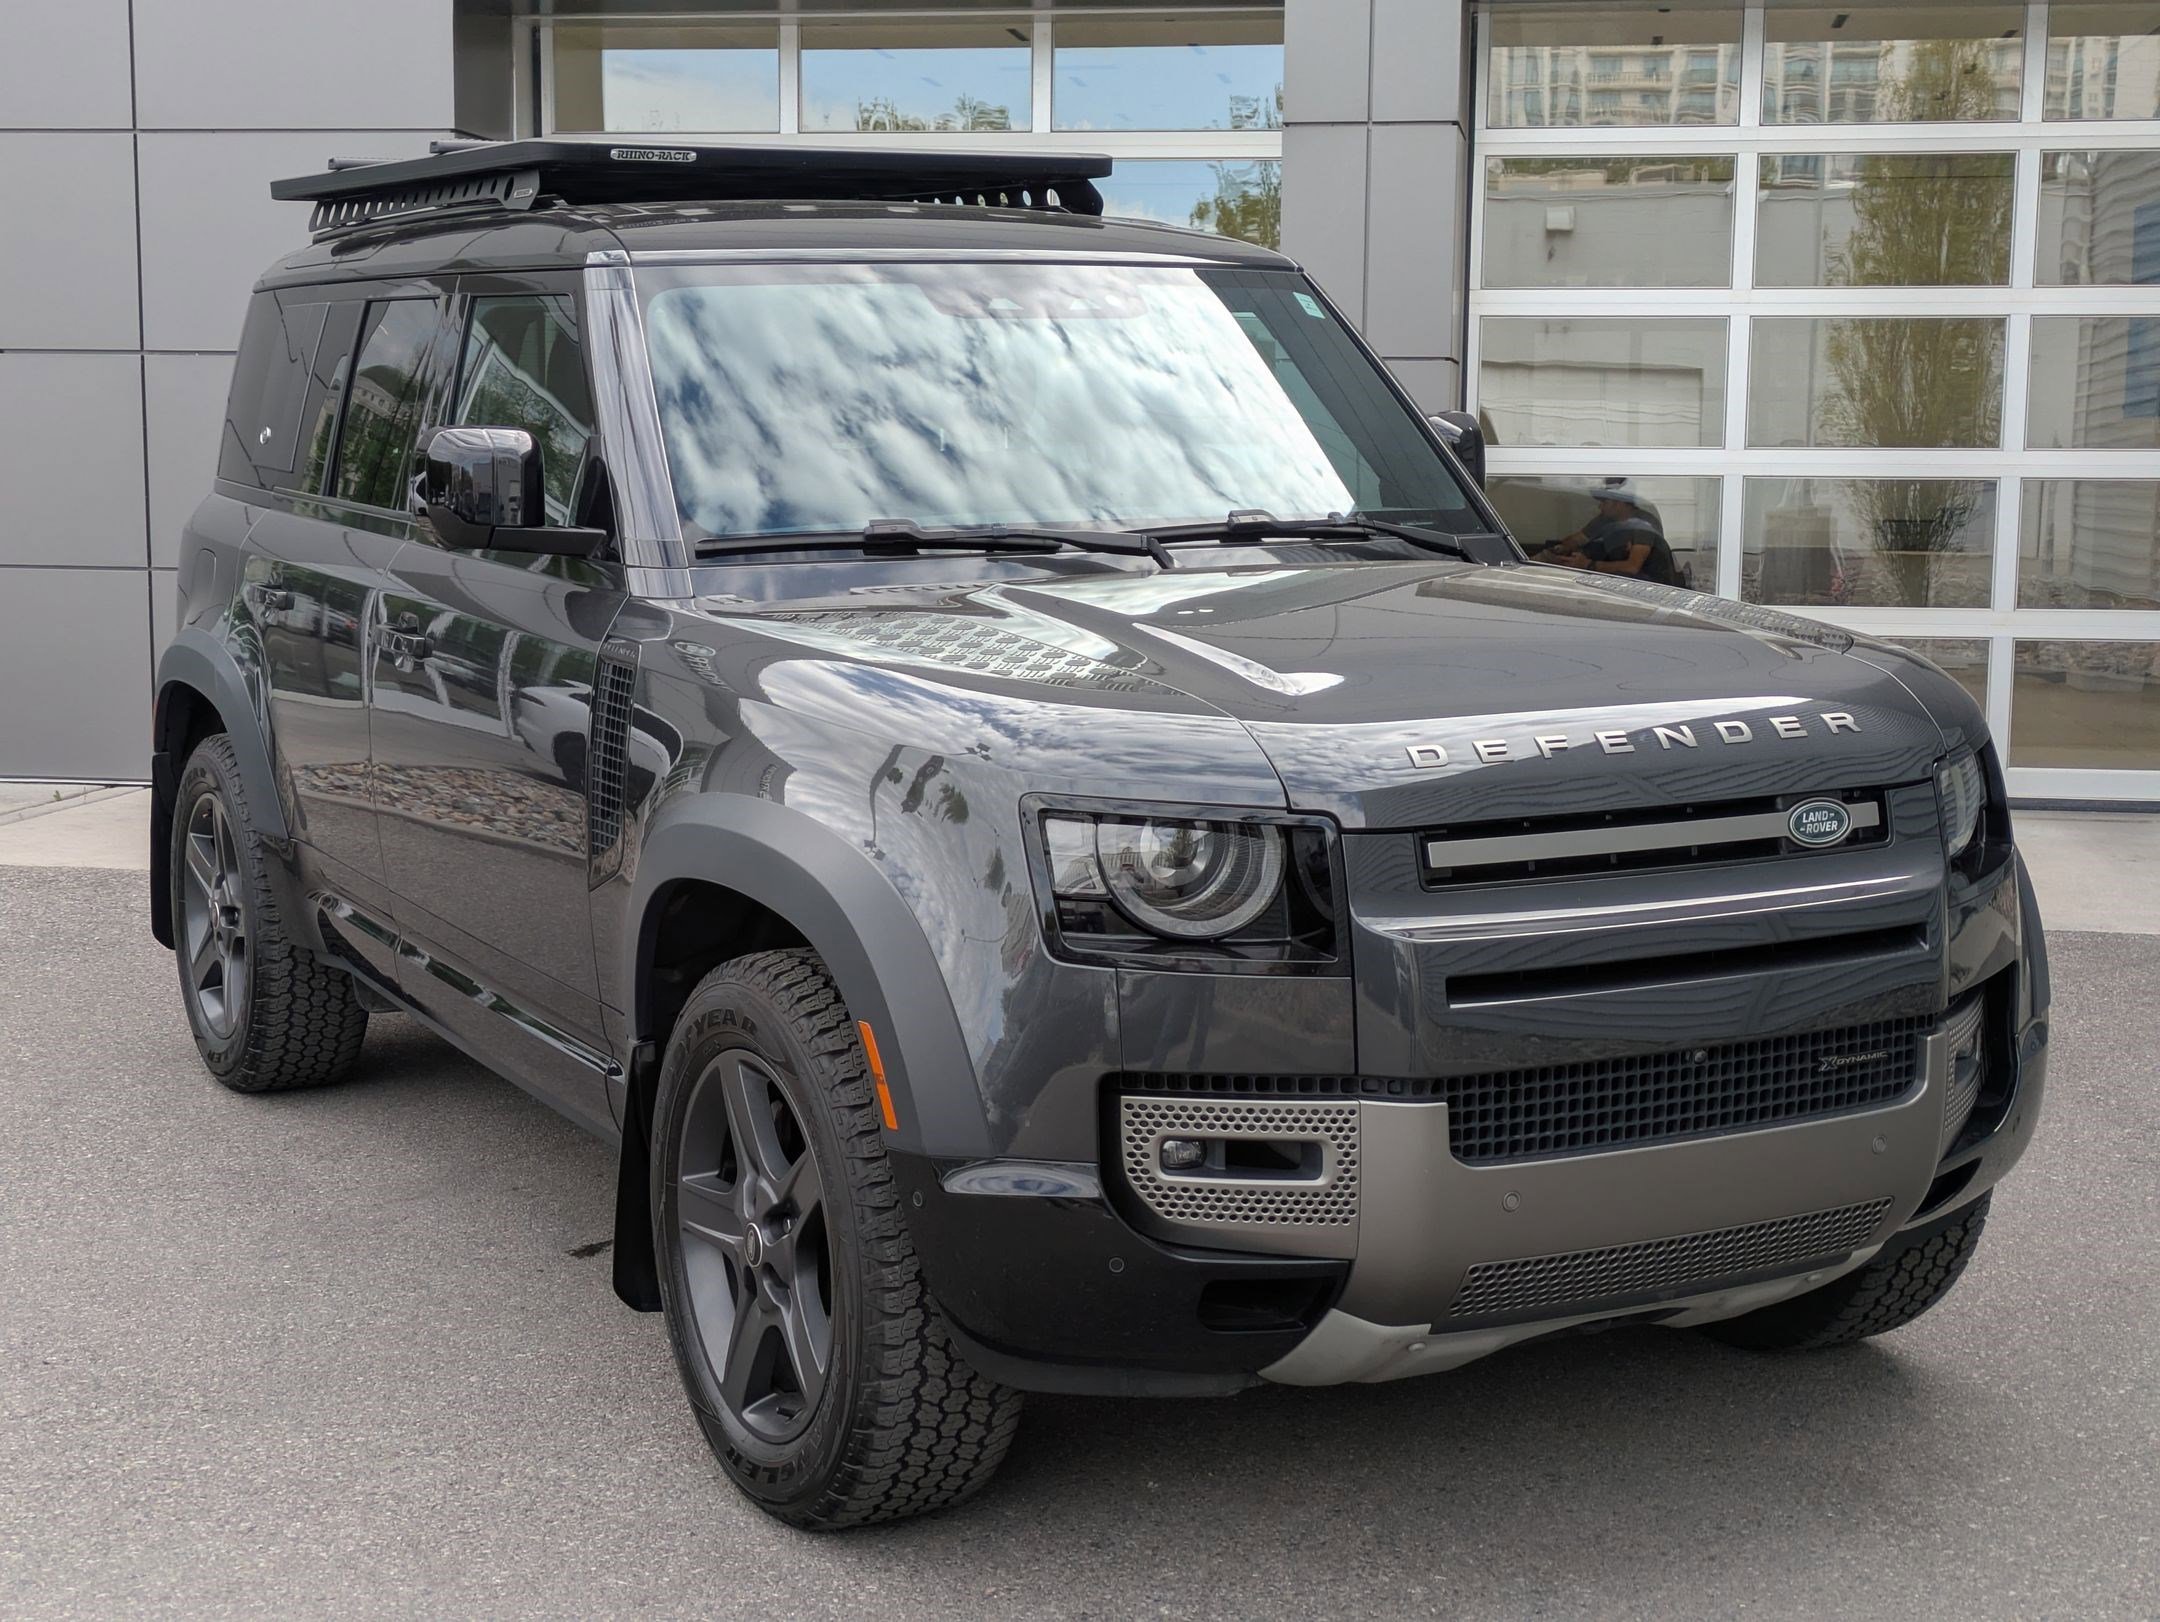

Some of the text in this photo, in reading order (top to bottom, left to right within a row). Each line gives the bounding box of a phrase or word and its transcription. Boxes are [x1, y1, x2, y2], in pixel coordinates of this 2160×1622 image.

[616, 149, 690, 161] RHINO-RACK
[1405, 711, 1862, 769] DEFENDER
[1802, 810, 1829, 823] LAND
[1806, 821, 1838, 834] ROVER
